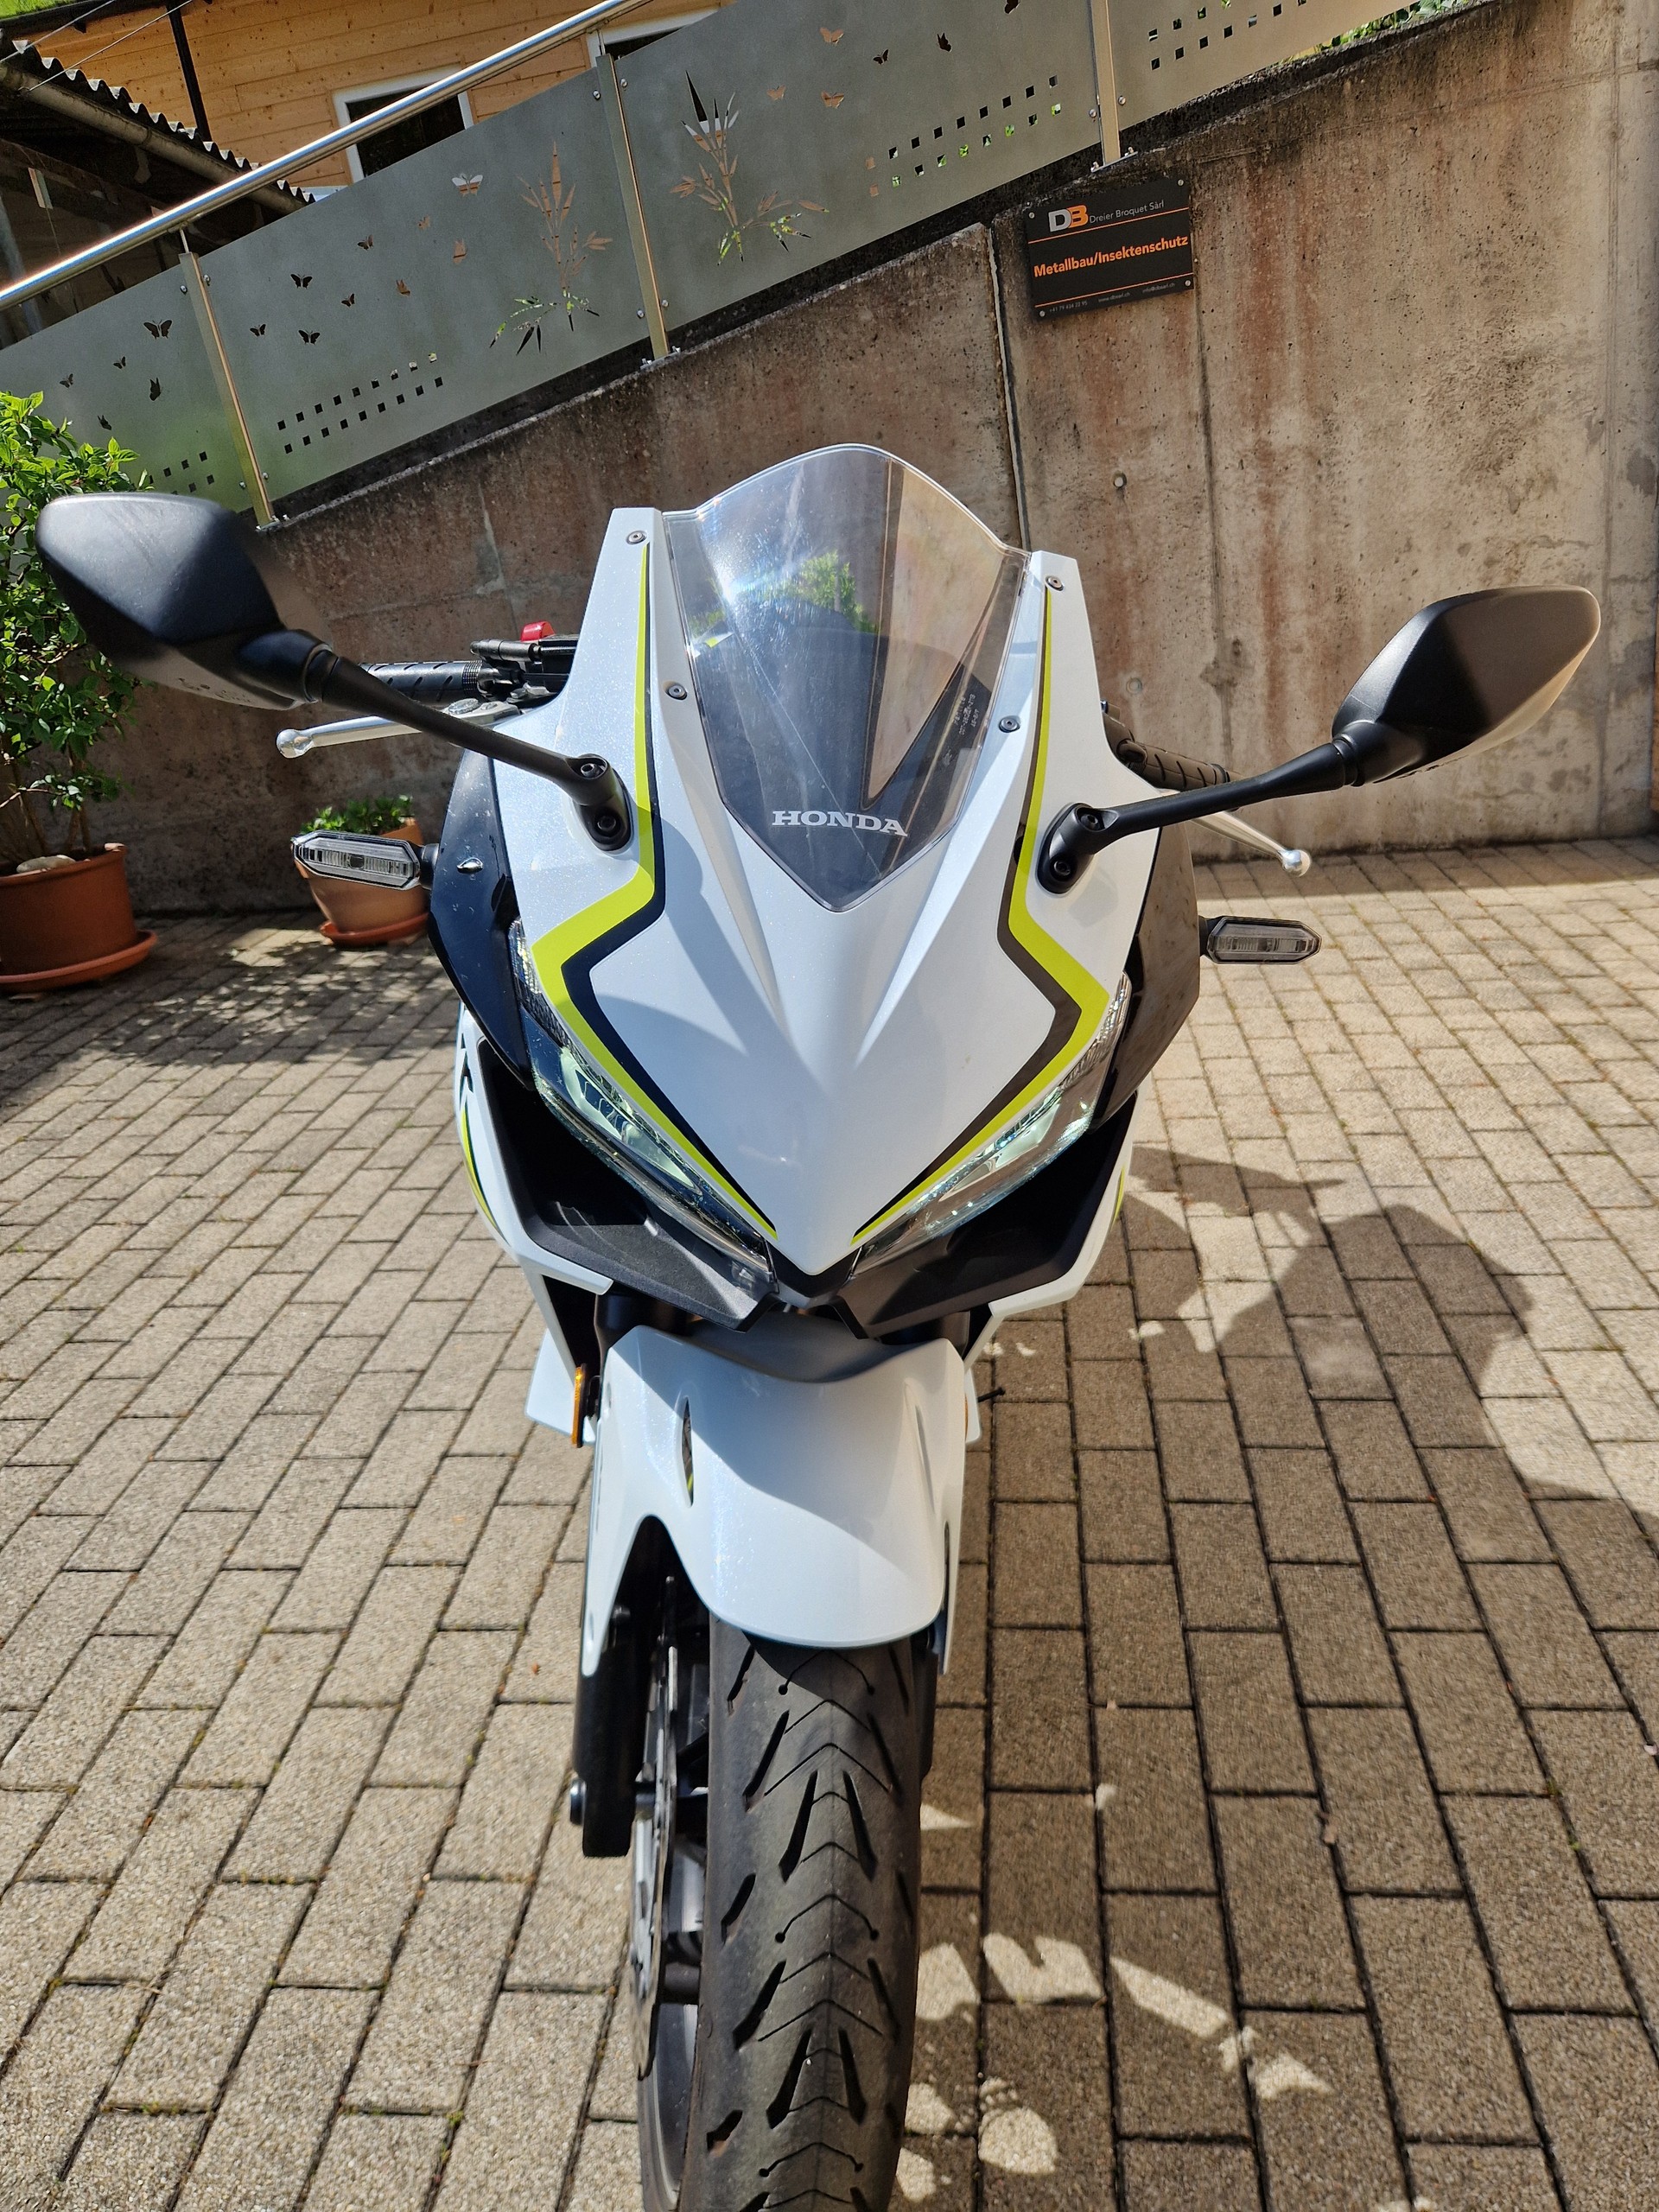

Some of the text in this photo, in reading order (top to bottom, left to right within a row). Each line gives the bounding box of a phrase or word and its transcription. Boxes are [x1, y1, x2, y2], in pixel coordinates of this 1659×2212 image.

[1047, 205, 1089, 232] DB
[1089, 212, 1115, 224] Dreier
[1116, 204, 1147, 219] Broquet
[1033, 235, 1189, 277] Metallbau/Insektenschutz
[772, 810, 908, 836] HONDA
